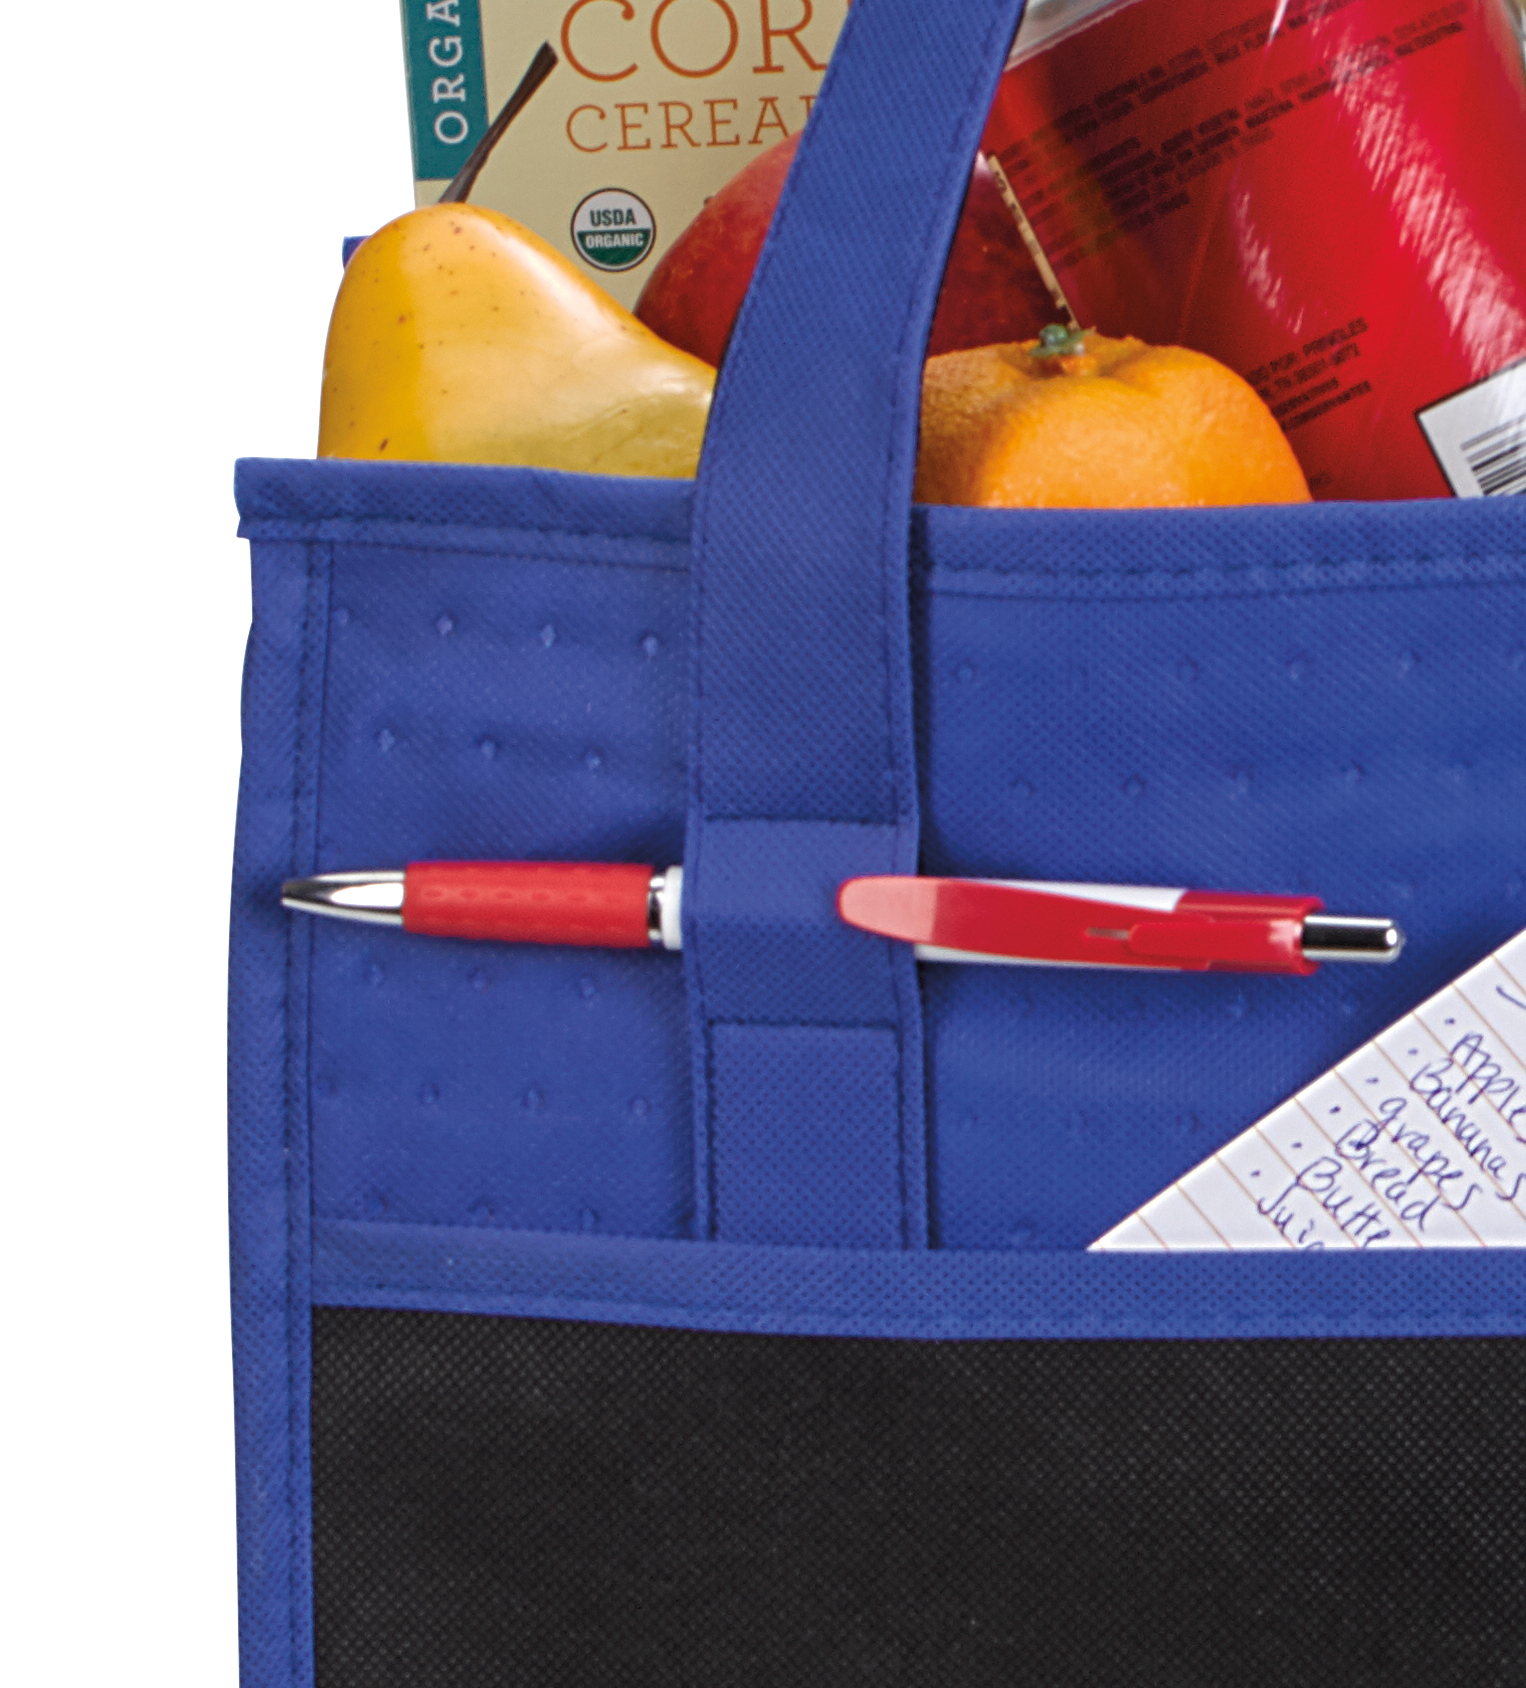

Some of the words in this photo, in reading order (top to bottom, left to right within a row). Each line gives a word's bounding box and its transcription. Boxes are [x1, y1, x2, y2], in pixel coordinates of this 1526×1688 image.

[566, 94, 818, 153] CEREA
[585, 232, 645, 249] ORGANIC
[589, 207, 637, 227] USDA
[1296, 1156, 1391, 1248] Butte
[1334, 1118, 1440, 1233] Bread
